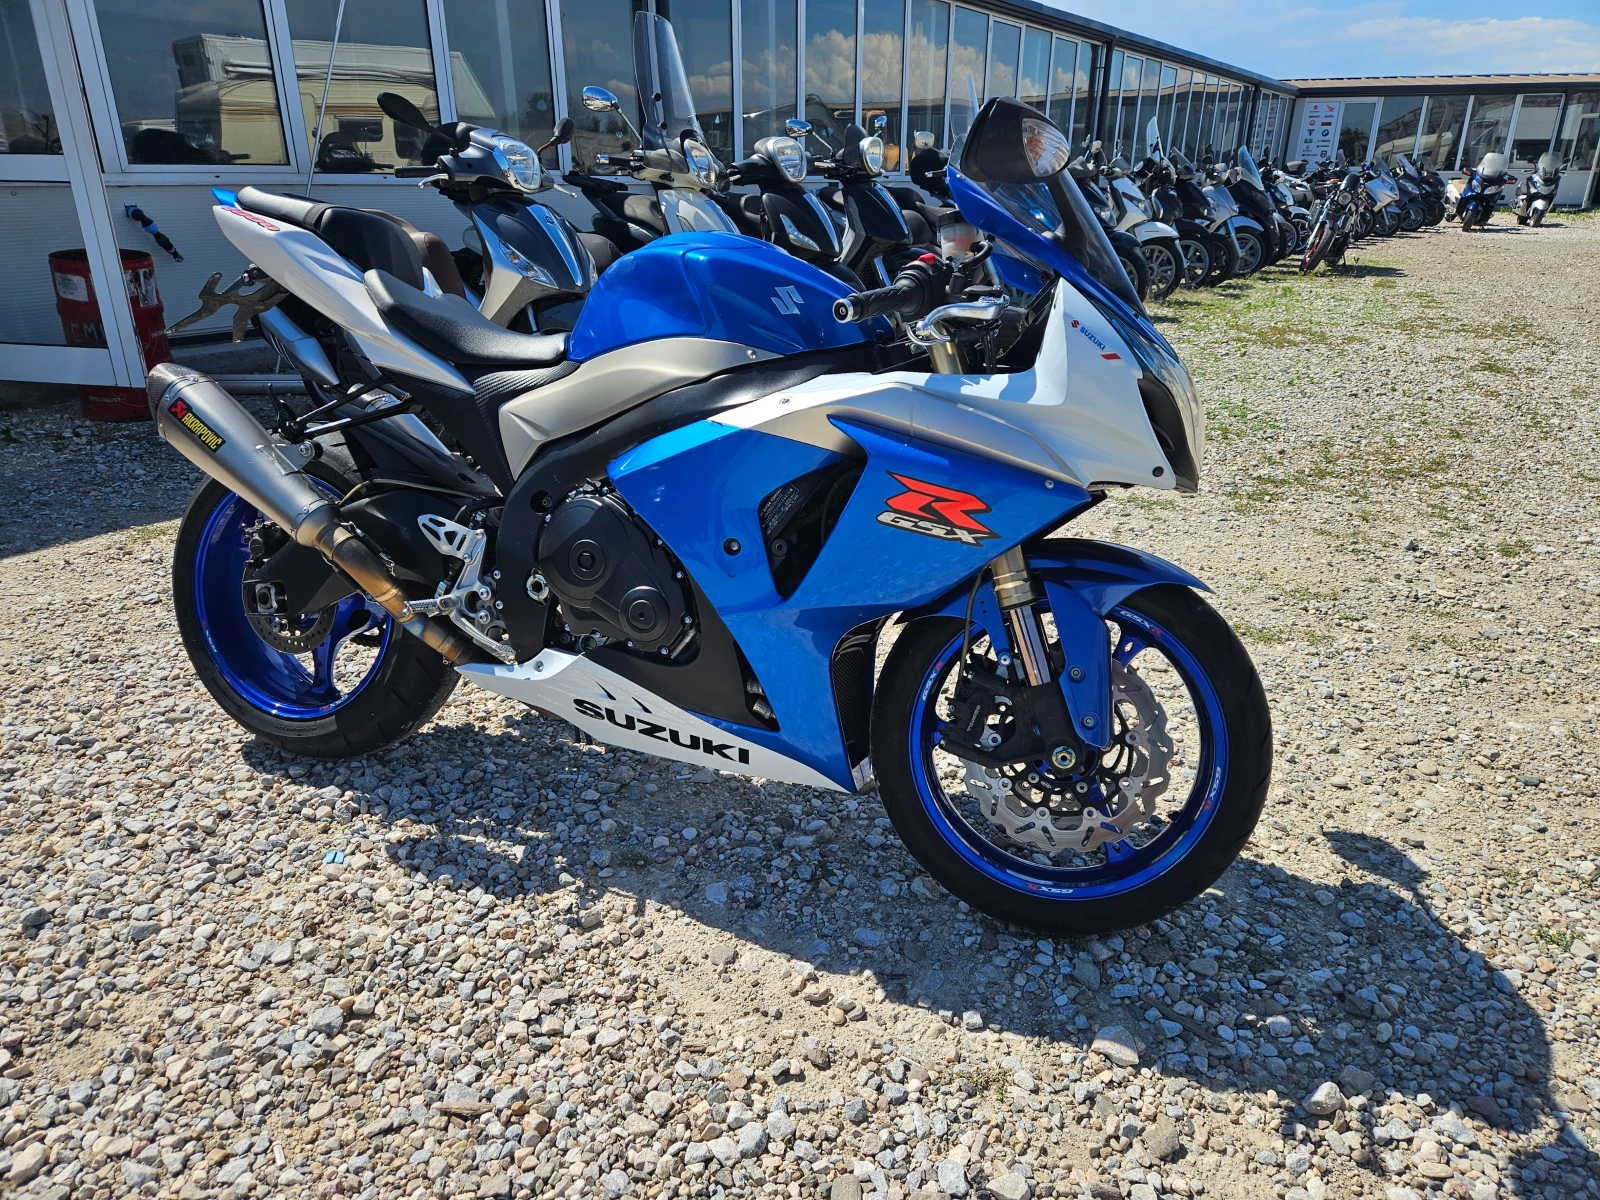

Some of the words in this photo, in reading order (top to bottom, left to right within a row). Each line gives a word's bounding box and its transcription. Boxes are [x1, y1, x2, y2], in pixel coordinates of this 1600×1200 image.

[1080, 326, 1106, 351] SUZUKI
[886, 472, 989, 533] R
[876, 511, 990, 544] GSX
[573, 698, 750, 765] SUZUKI
